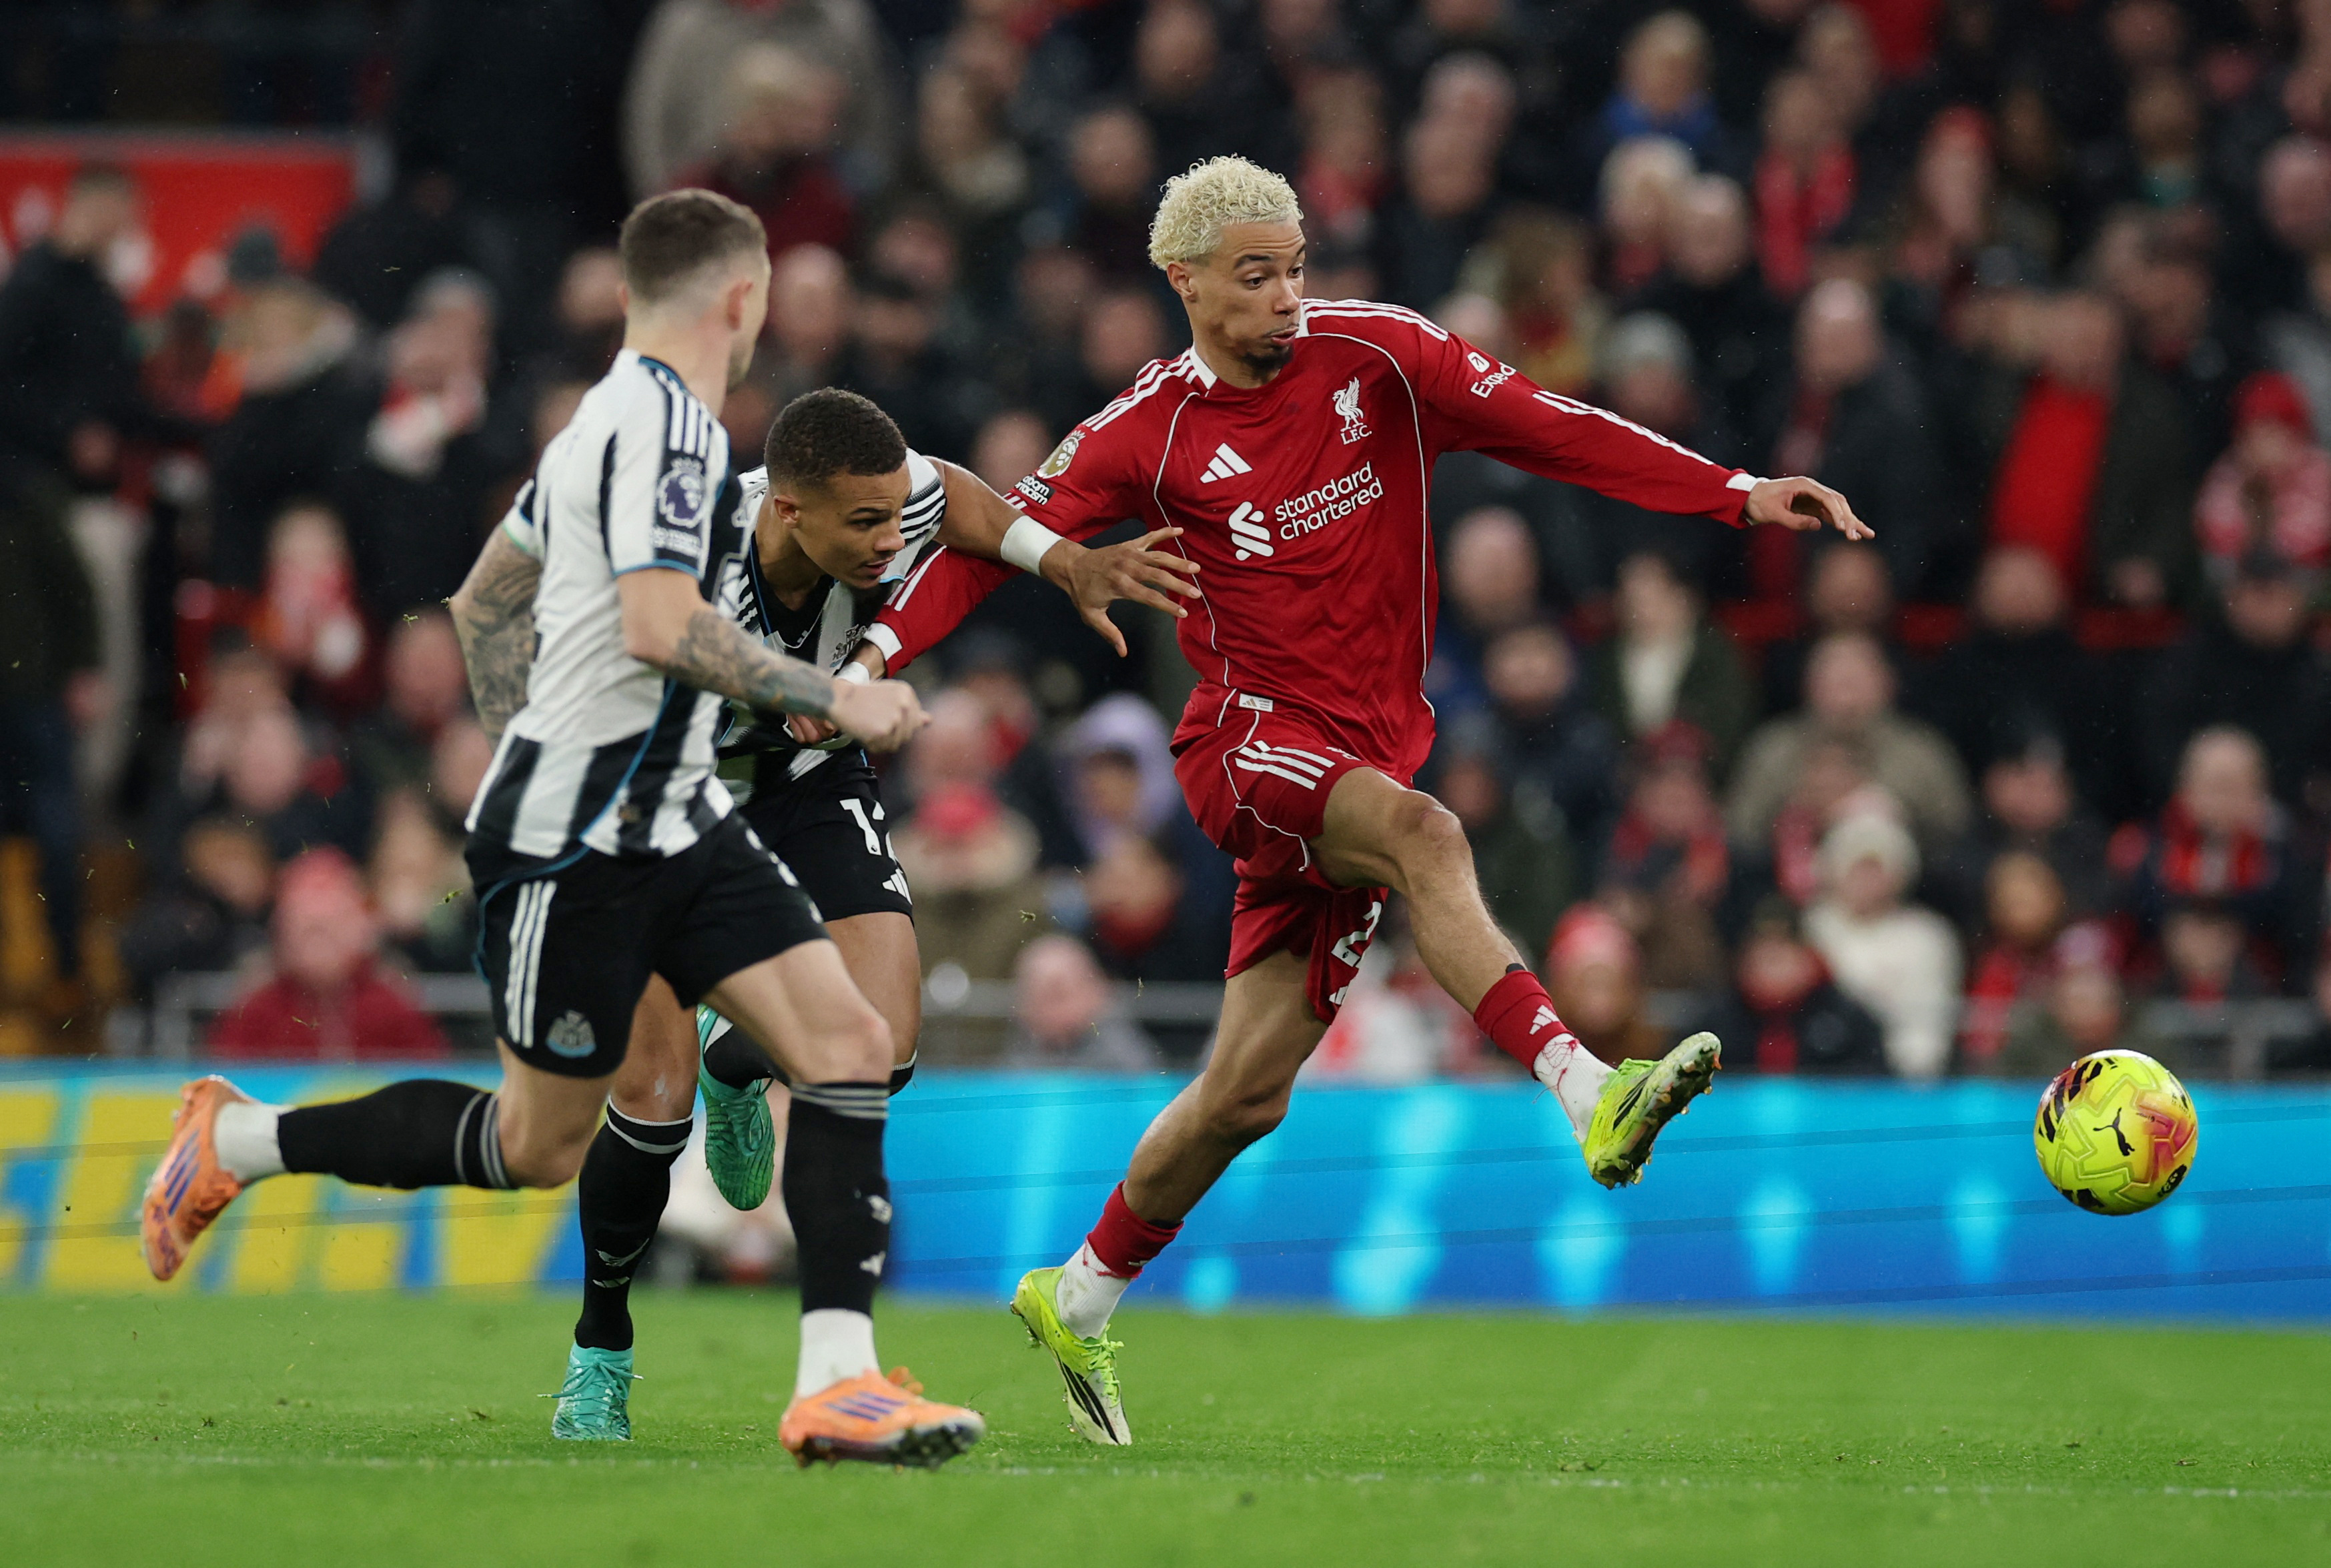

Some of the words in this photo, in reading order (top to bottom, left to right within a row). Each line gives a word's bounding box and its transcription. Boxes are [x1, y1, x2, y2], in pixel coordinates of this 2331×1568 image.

[1274, 461, 1373, 522] standard
[1280, 477, 1384, 540] chartered
[1331, 901, 1382, 969] 2
